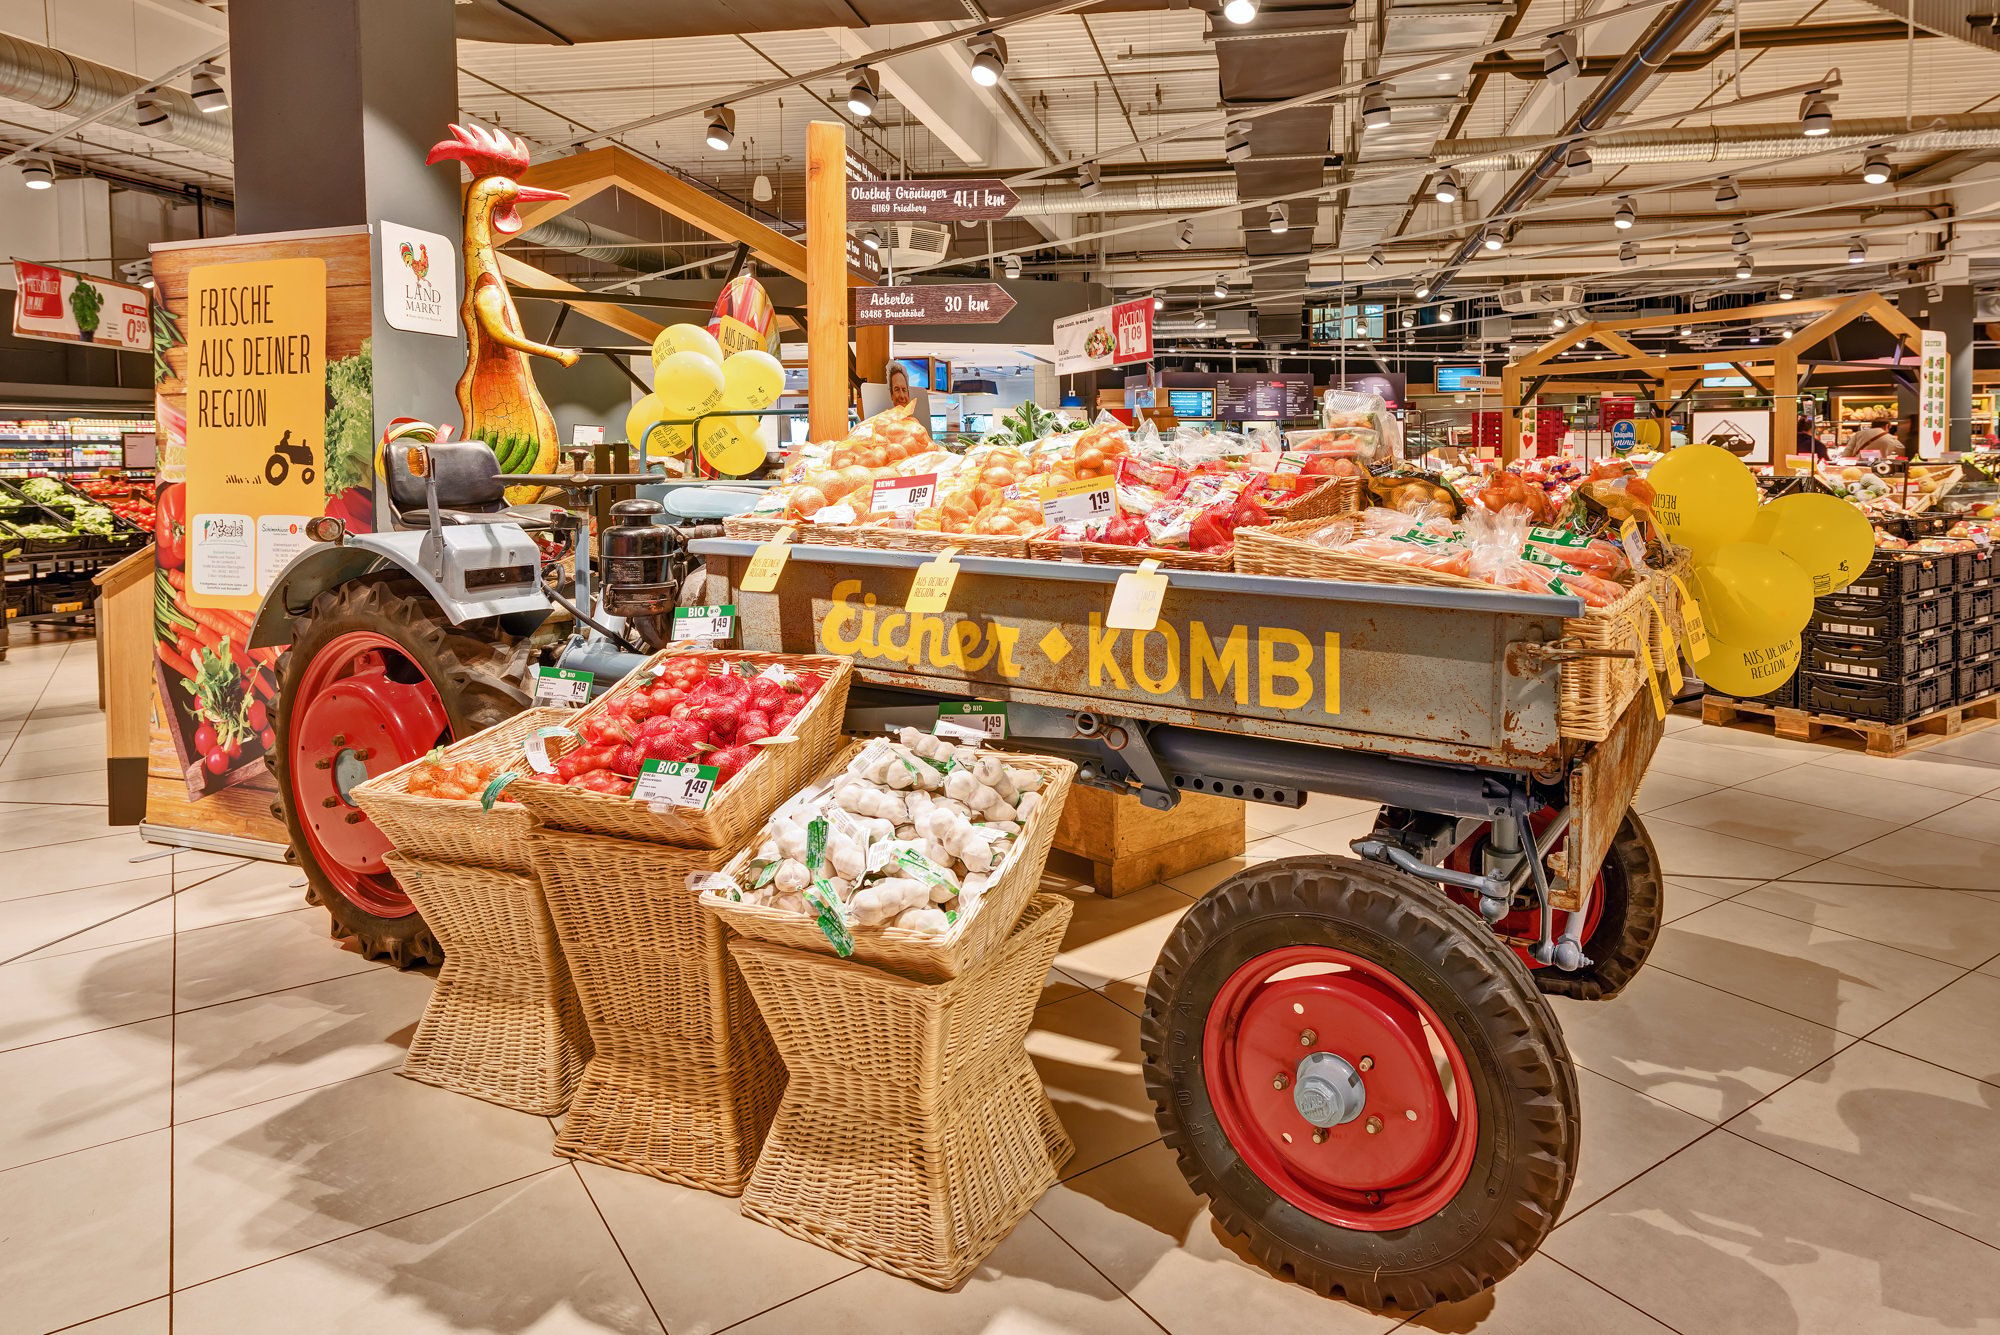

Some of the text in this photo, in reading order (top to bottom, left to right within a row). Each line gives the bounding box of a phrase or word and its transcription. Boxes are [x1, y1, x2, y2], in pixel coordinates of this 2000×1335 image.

[851, 187, 1006, 208] Obsthof Gröninger 41,1 km
[871, 203, 927, 214] 61169 Friedberg
[405, 284, 441, 304] LAND
[870, 292, 989, 312] Ackerlei 30 km
[200, 284, 274, 327] FRISCHE
[405, 300, 442, 315] MARKT
[860, 308, 926, 319] 63486 Bruchköbel
[1120, 308, 1145, 328] AKTION
[127, 318, 147, 343] 0.99
[723, 326, 736, 349] AUS
[1123, 325, 1142, 354] 1.09
[198, 334, 311, 378] AUS DEINER
[198, 388, 267, 428] REGION
[708, 427, 729, 443] DEINER
[1614, 439, 1635, 447] minis
[875, 480, 896, 488] REWE
[908, 487, 928, 503] 0.99
[1088, 491, 1110, 510] 1.19
[1652, 494, 1677, 510] REGIO
[1664, 511, 1681, 526] AUS
[915, 576, 950, 587] AUS DEINER
[914, 587, 936, 599] REGION
[688, 607, 705, 617] BIO
[711, 617, 728, 632] 1.49
[820, 580, 1341, 715] Eicher KOMBI
[1743, 649, 1764, 666] AUS
[1750, 657, 1786, 680] REGION
[572, 681, 587, 694] 1.49
[982, 715, 1001, 732] 1.49
[656, 761, 679, 775] BIO
[683, 778, 708, 798] 1.49
